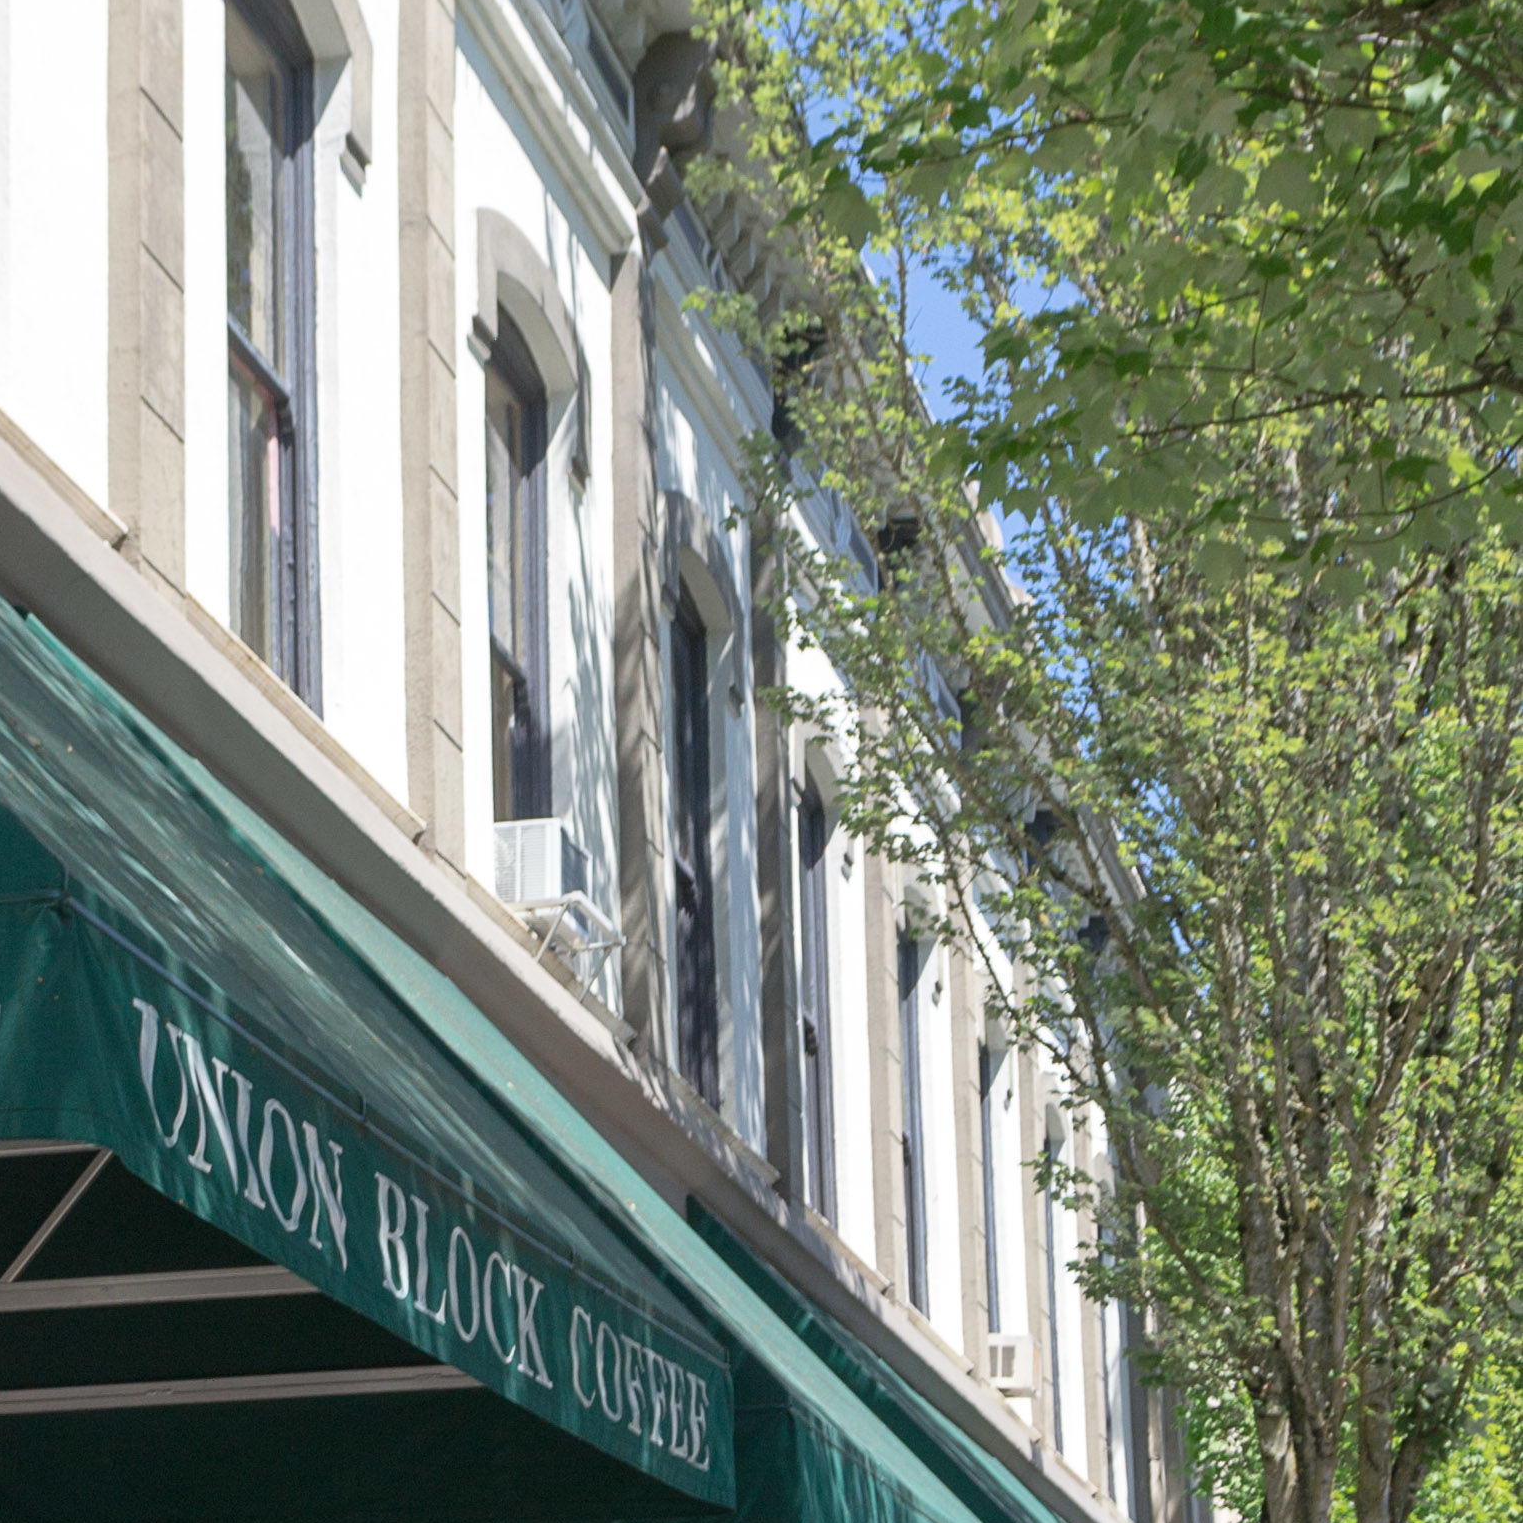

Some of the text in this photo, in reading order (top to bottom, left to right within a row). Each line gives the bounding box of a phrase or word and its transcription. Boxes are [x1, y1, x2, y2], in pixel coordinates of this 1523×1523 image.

[132, 997, 711, 1473] UNION BLOCK COFFEE
